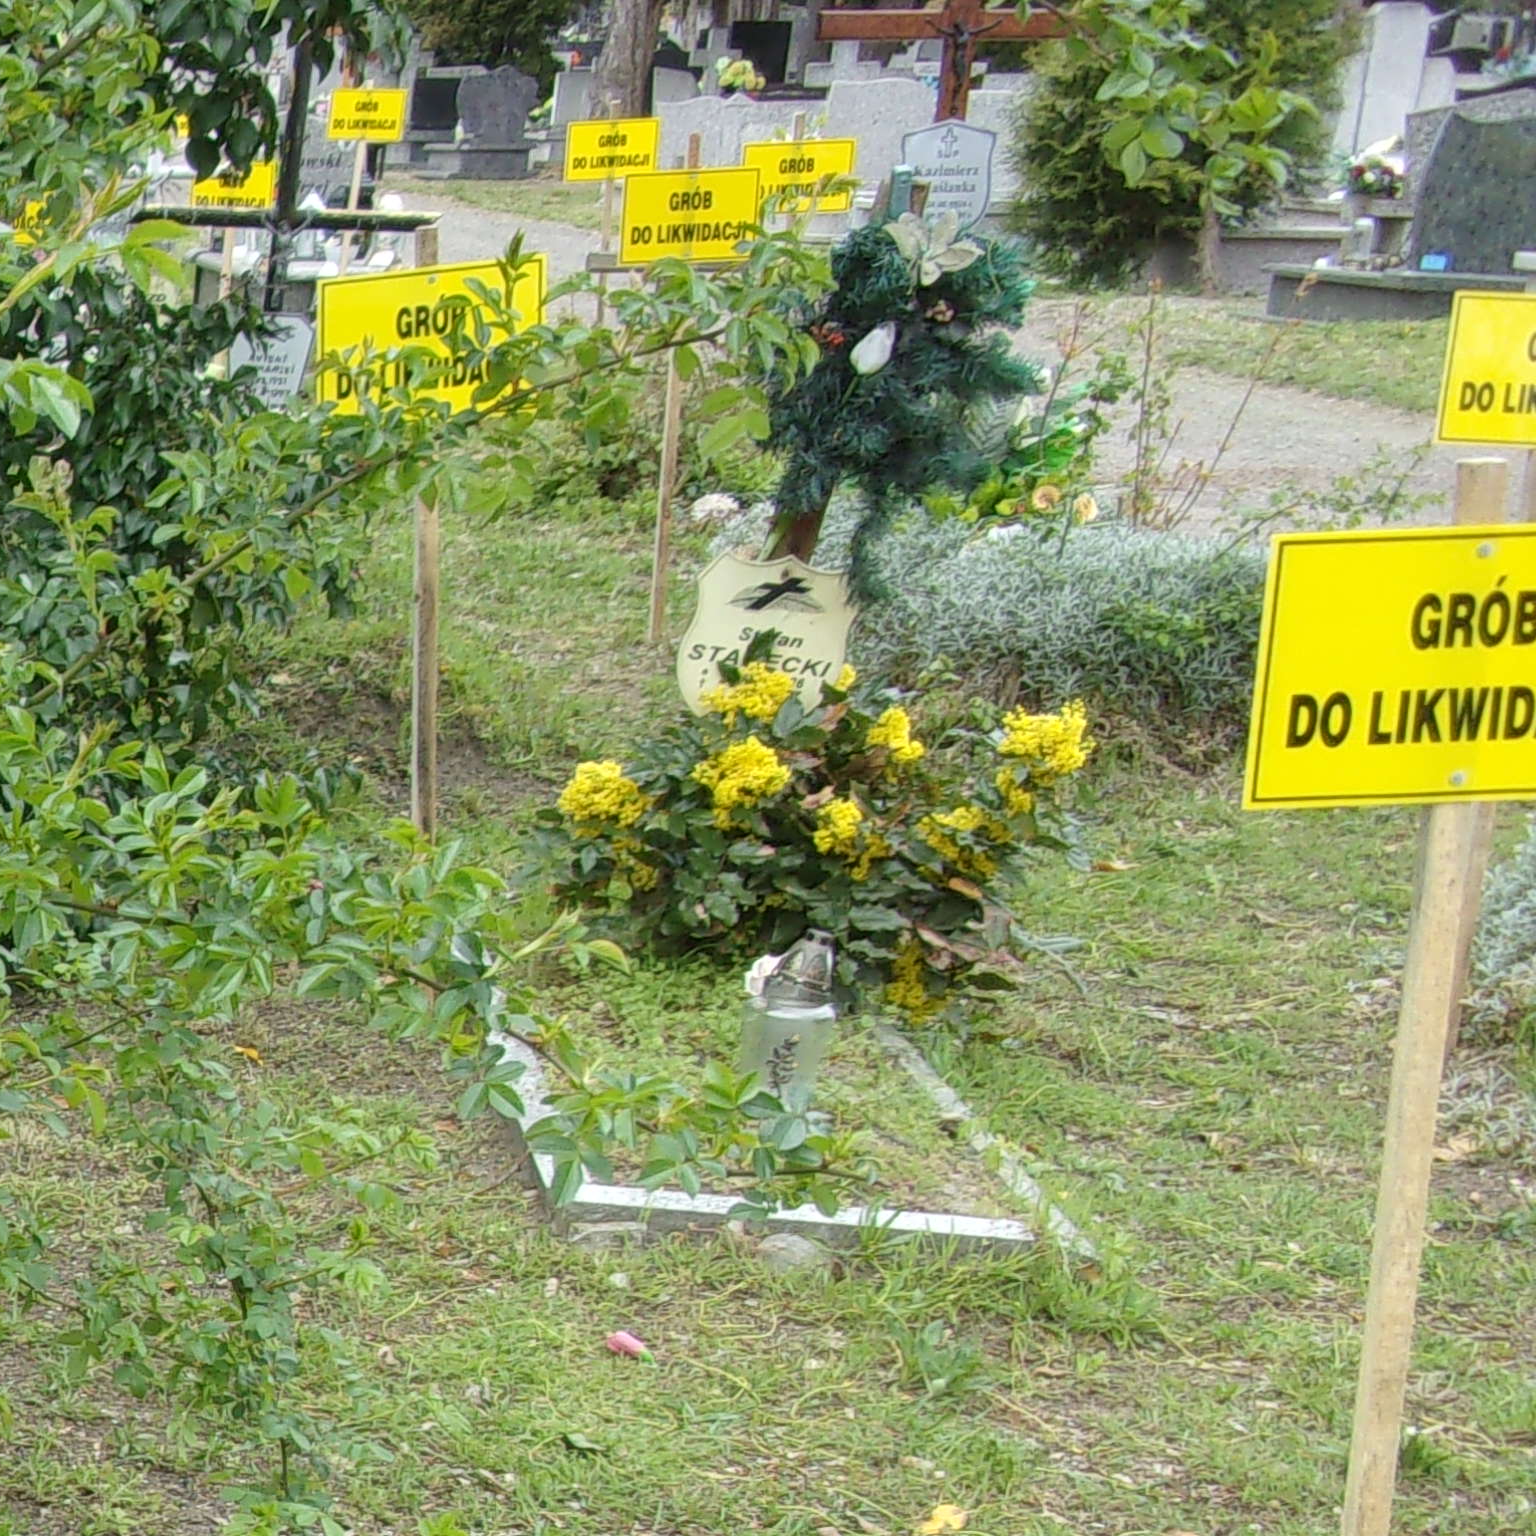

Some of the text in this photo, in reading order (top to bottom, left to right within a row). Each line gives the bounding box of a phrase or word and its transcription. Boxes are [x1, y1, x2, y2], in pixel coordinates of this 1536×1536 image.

[598, 130, 627, 148] GRÓB
[572, 153, 650, 170] DO LIKWIDACJI
[779, 154, 815, 174] GRÓB
[669, 186, 712, 211] GRÓB
[631, 221, 747, 245] DO LIKWIDACJI
[1459, 381, 1495, 412] DO
[1411, 576, 1536, 650] GRÓB
[688, 644, 833, 677] STAECKI
[1286, 686, 1536, 748] DO LIKWID
